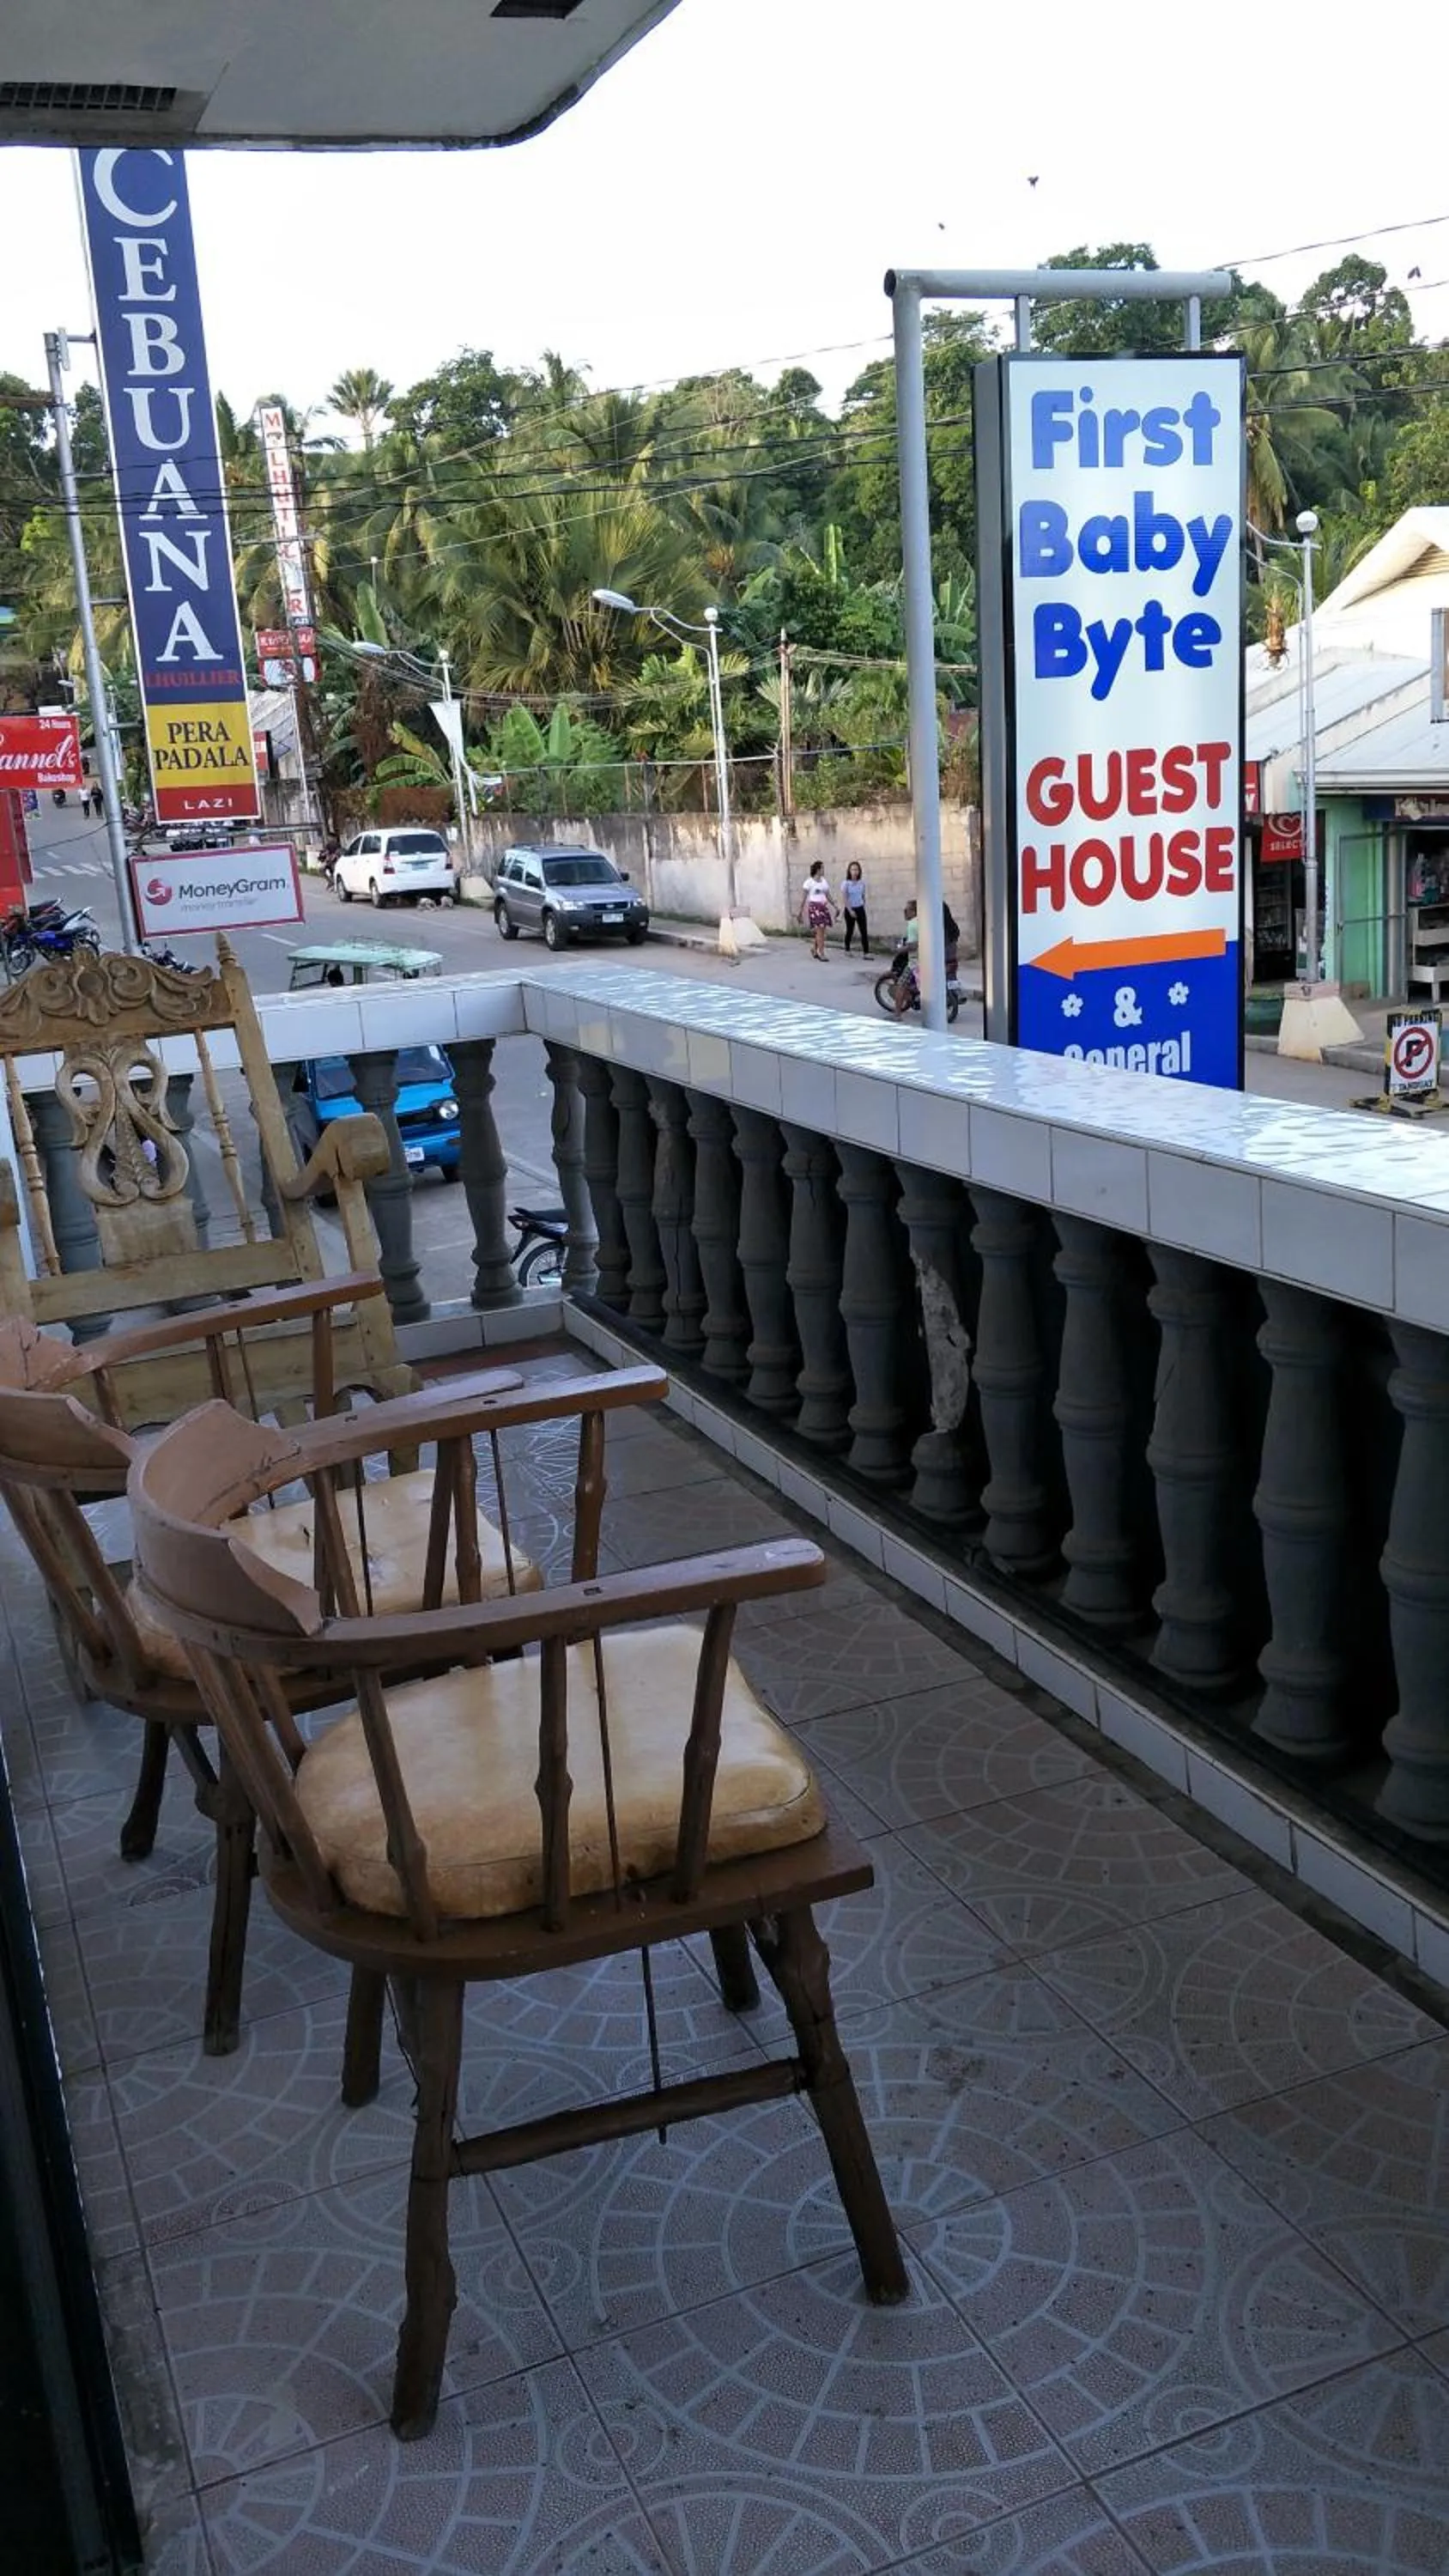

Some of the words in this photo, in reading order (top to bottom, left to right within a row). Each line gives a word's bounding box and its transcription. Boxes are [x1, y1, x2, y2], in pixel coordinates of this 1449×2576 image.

[93, 149, 224, 662] CEBUANA
[1032, 386, 1222, 469] First
[1019, 491, 1233, 597] Baby
[1034, 599, 1222, 702] Byte
[39, 719, 51, 729] 24
[167, 720, 231, 744] PERA
[0, 734, 76, 770] annel's
[153, 745, 251, 770] PADALA
[184, 798, 233, 810] LAZI
[1026, 742, 1231, 827] GUEST
[179, 878, 286, 899] MoneyGram
[1022, 826, 1235, 914] HOUSE
[1113, 987, 1143, 1028] &
